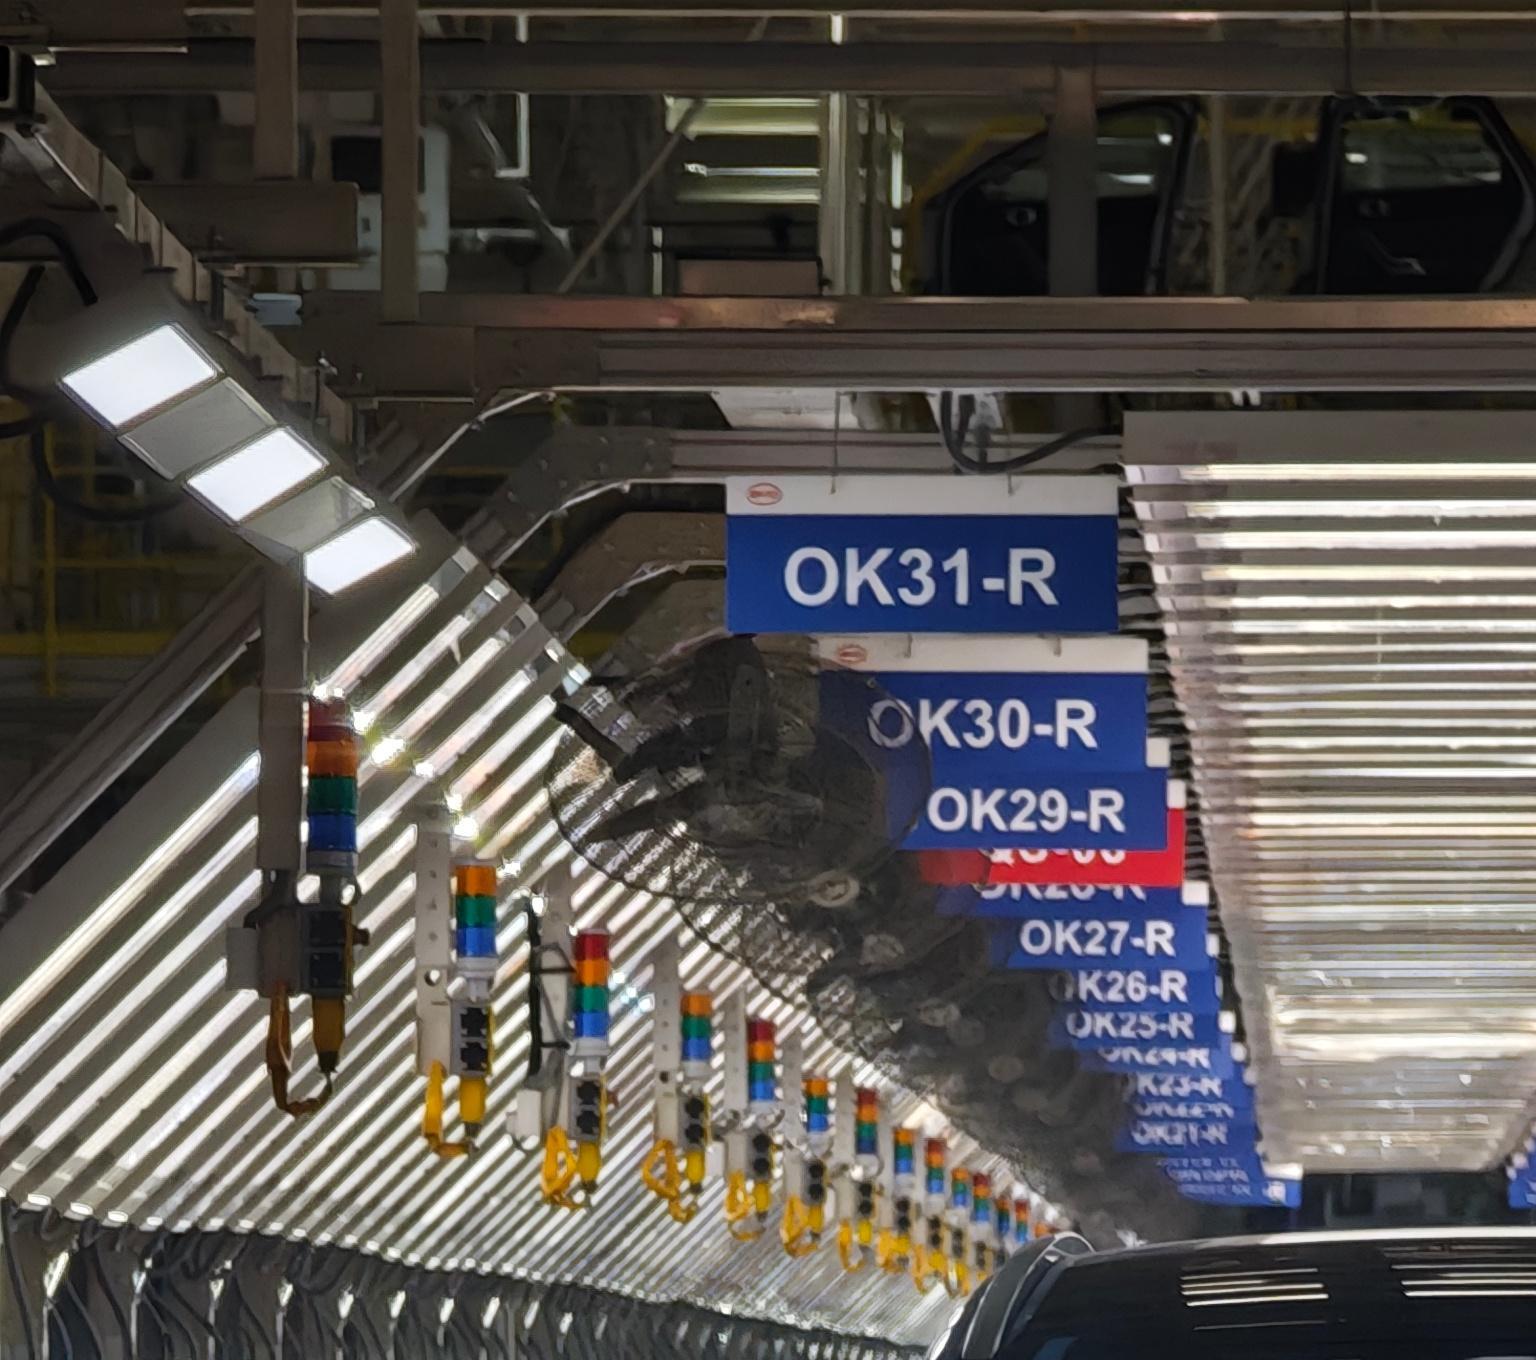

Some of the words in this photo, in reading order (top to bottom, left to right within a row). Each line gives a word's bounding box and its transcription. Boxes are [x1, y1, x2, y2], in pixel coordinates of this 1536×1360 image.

[783, 546, 1058, 607] OK31-R
[866, 697, 1099, 750] OK30-R
[927, 786, 1126, 833] OK29-R
[1019, 919, 1176, 957] OK27-R
